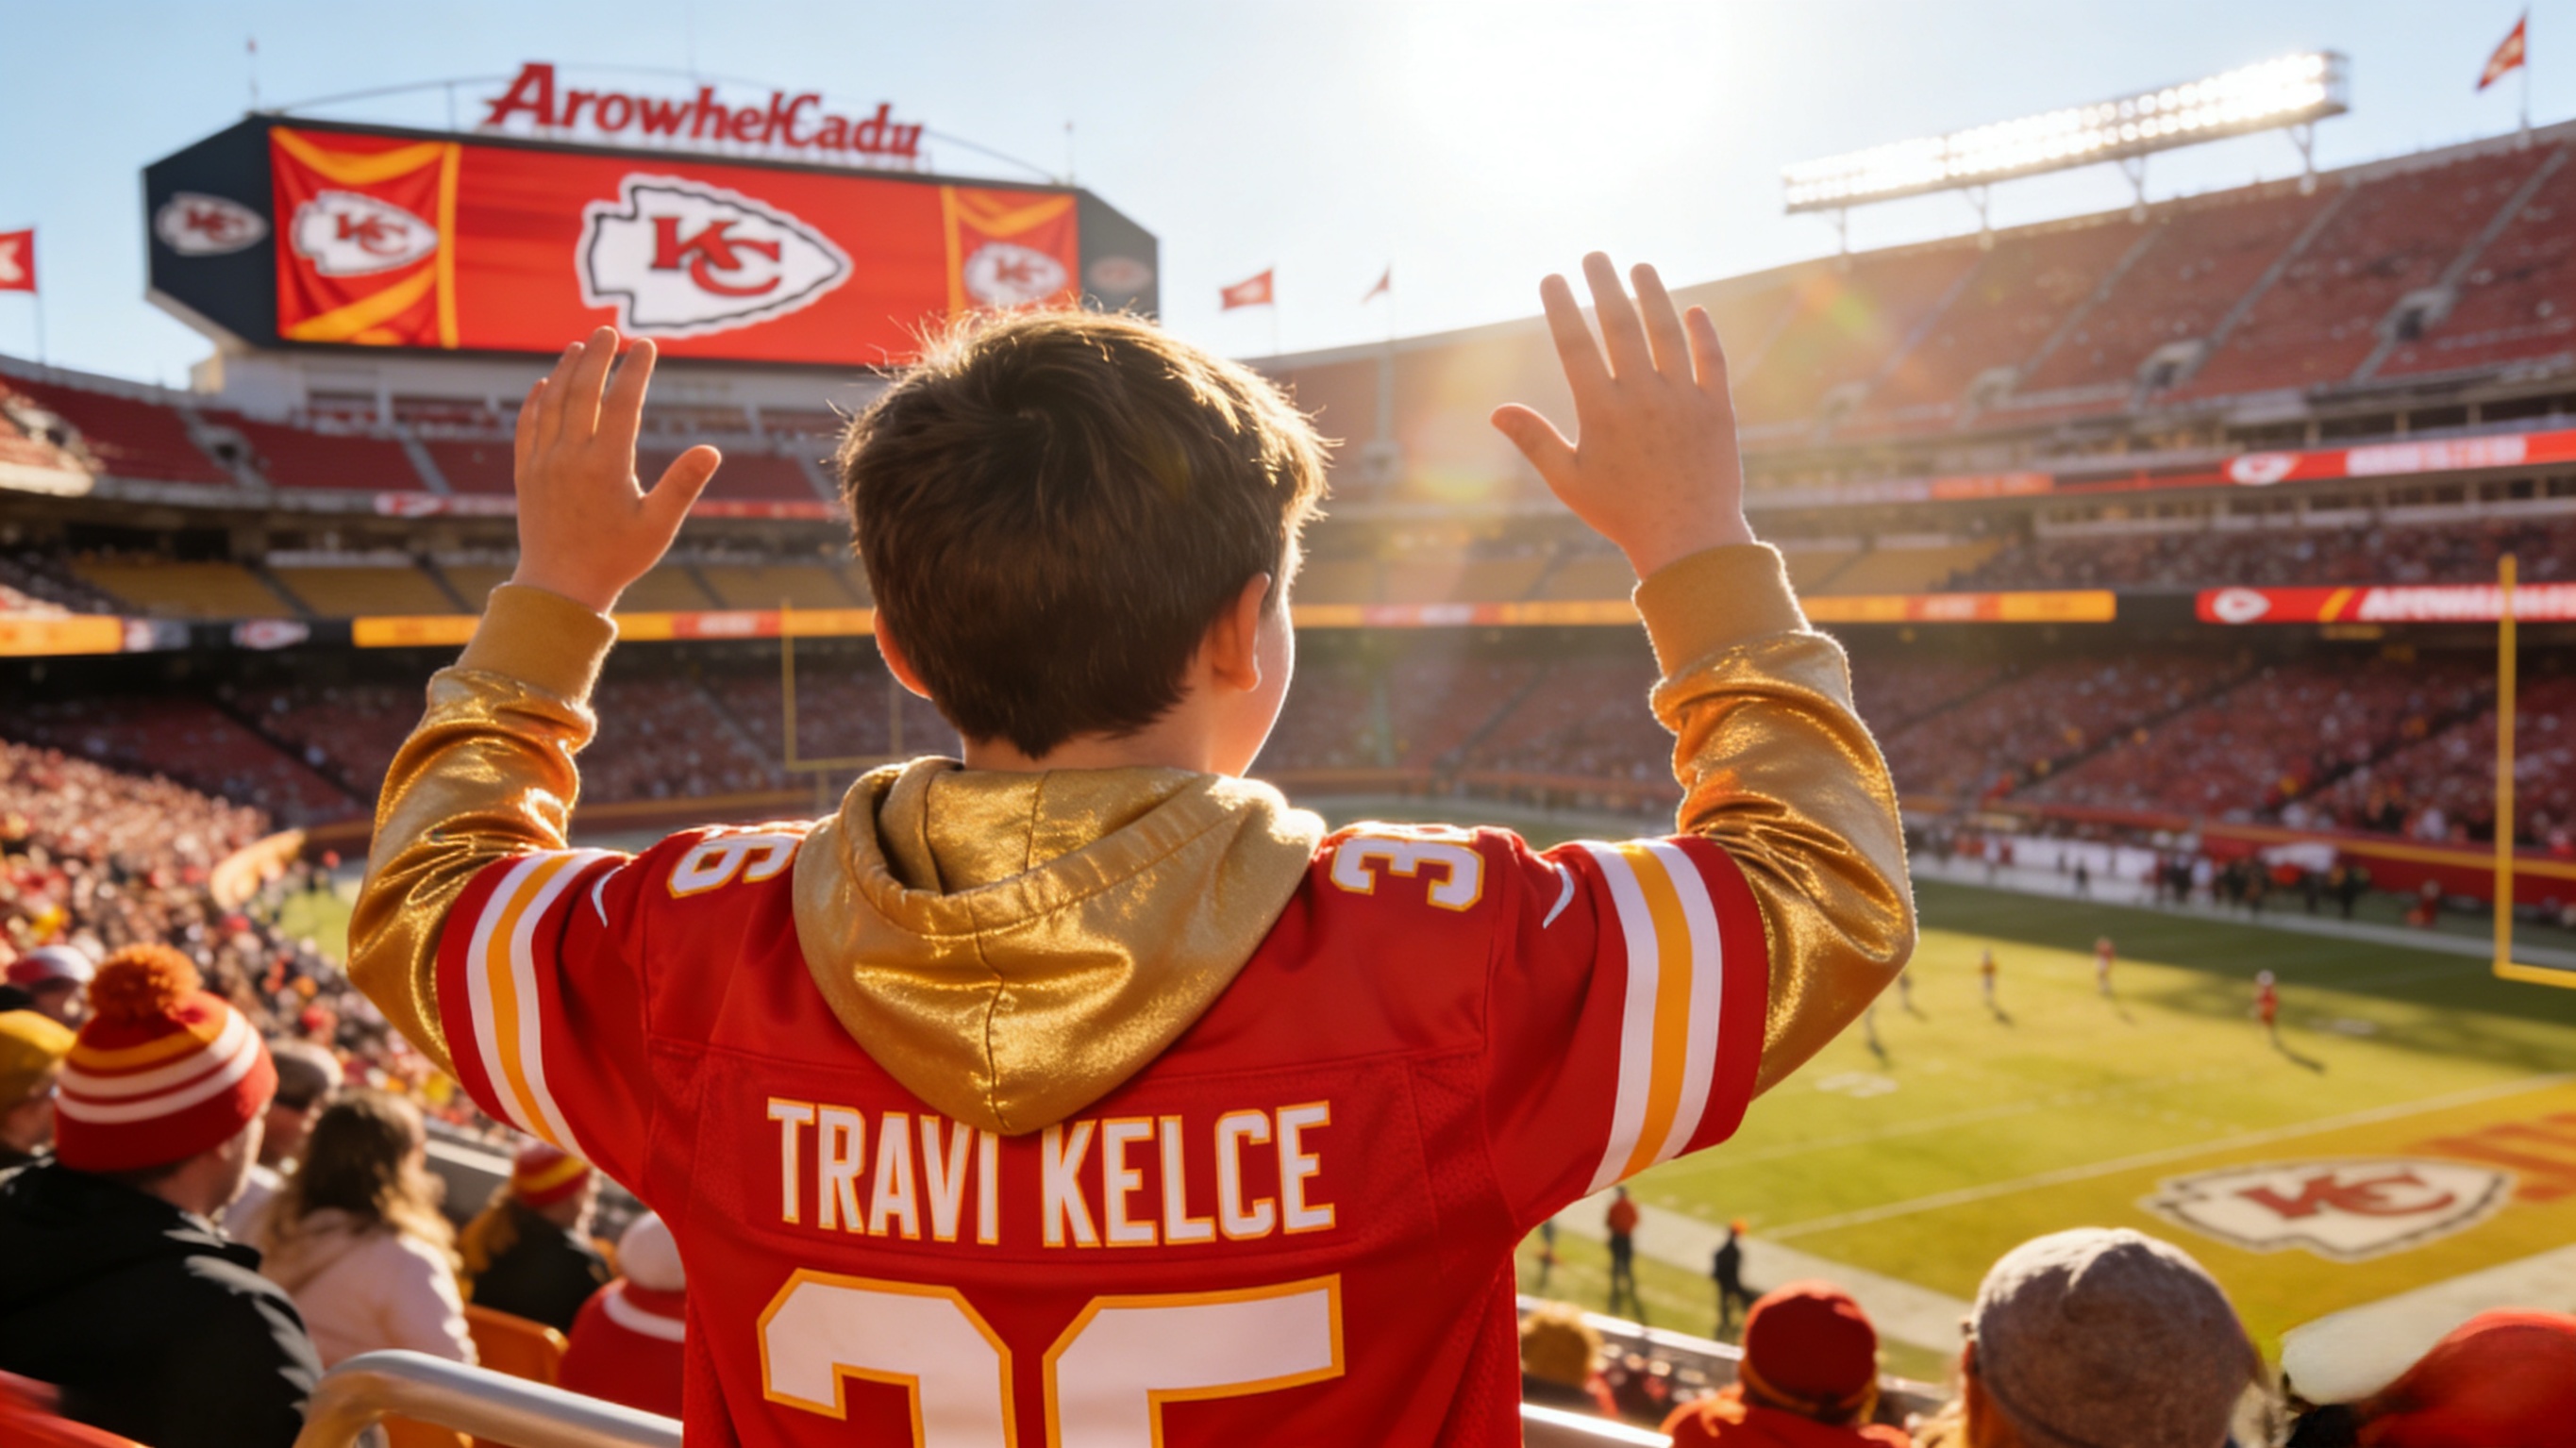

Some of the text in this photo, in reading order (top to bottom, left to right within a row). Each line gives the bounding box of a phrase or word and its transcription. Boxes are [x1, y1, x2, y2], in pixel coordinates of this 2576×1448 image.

[649, 215, 782, 299] KC
[767, 1096, 1336, 1248] TRAVI KELCE
[2233, 1166, 2458, 1221] KC
